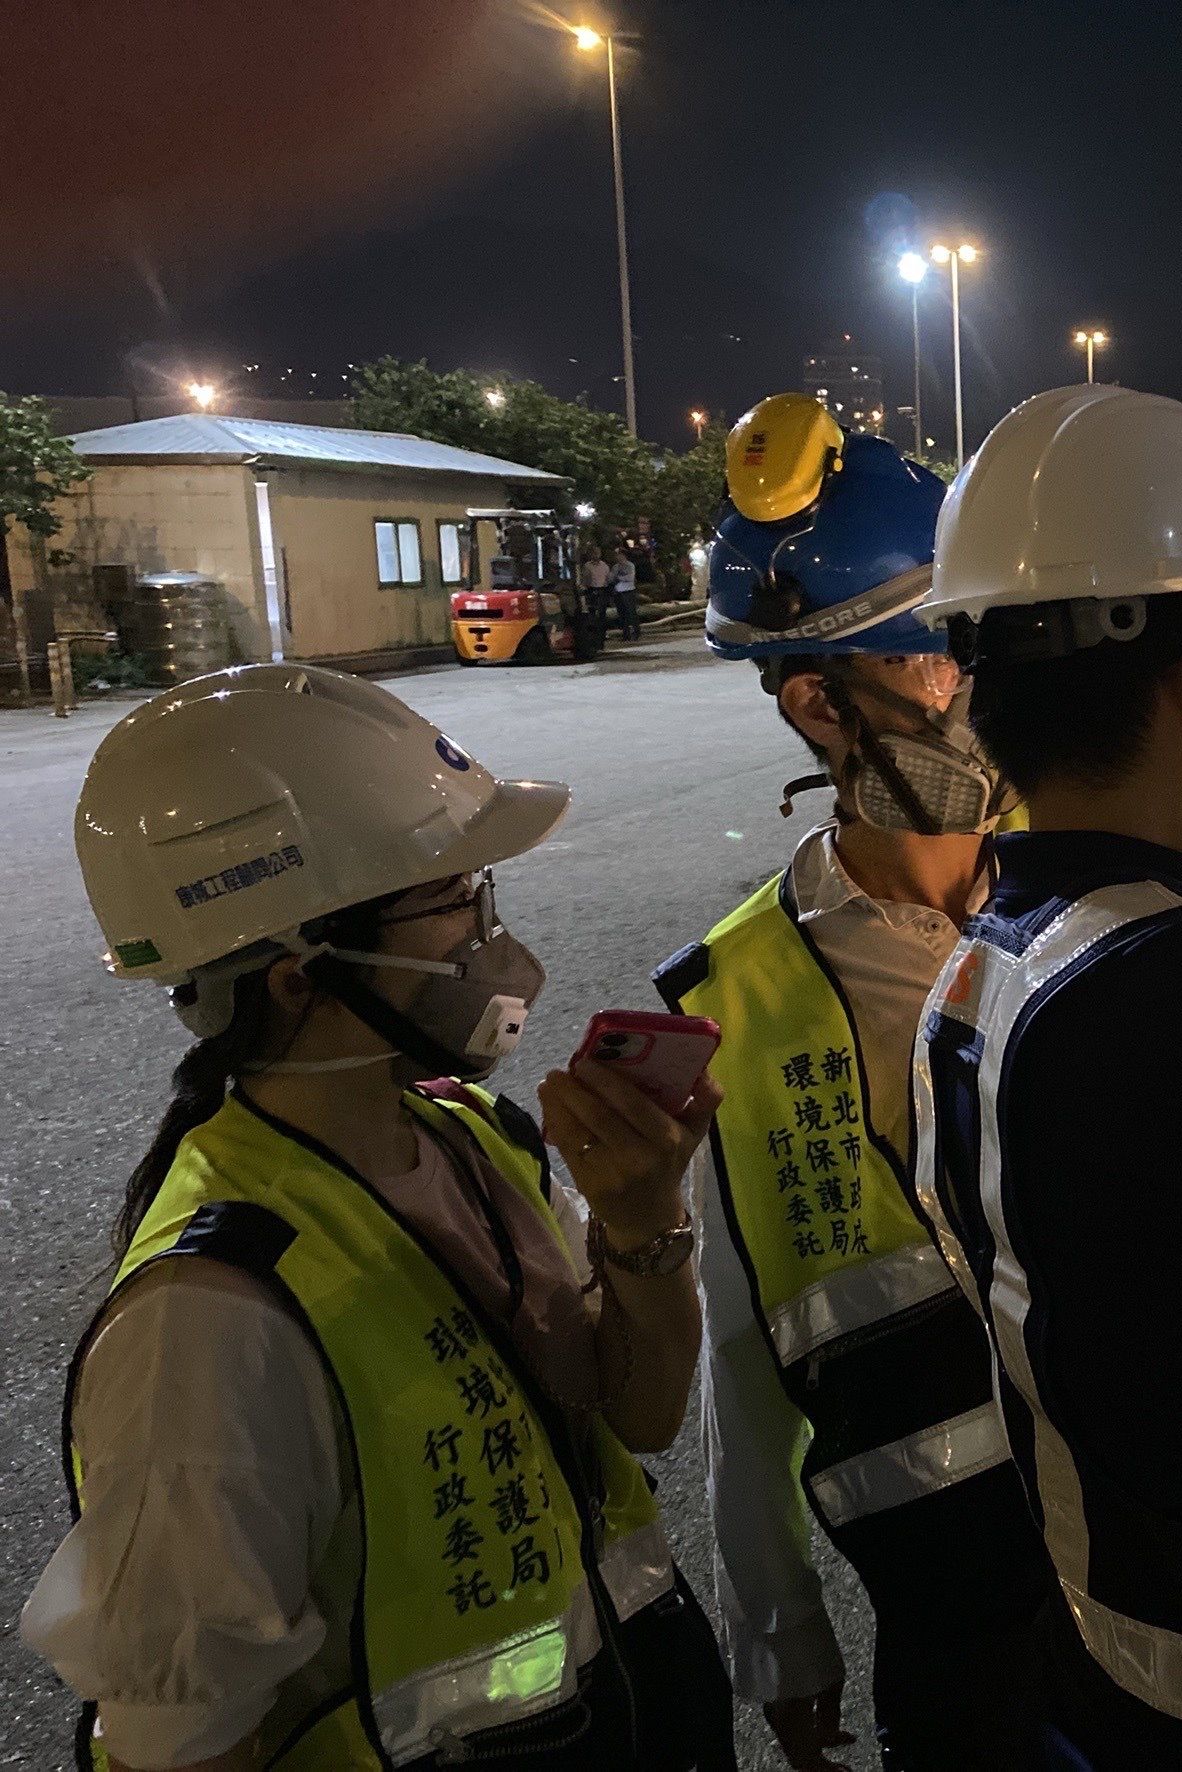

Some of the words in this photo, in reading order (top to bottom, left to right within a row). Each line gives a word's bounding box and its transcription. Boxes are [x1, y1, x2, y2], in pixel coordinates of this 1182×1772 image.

[766, 1127, 827, 1260] 行政委託
[780, 1052, 850, 1258] 環境保護局
[422, 1424, 497, 1616] 行政委託
